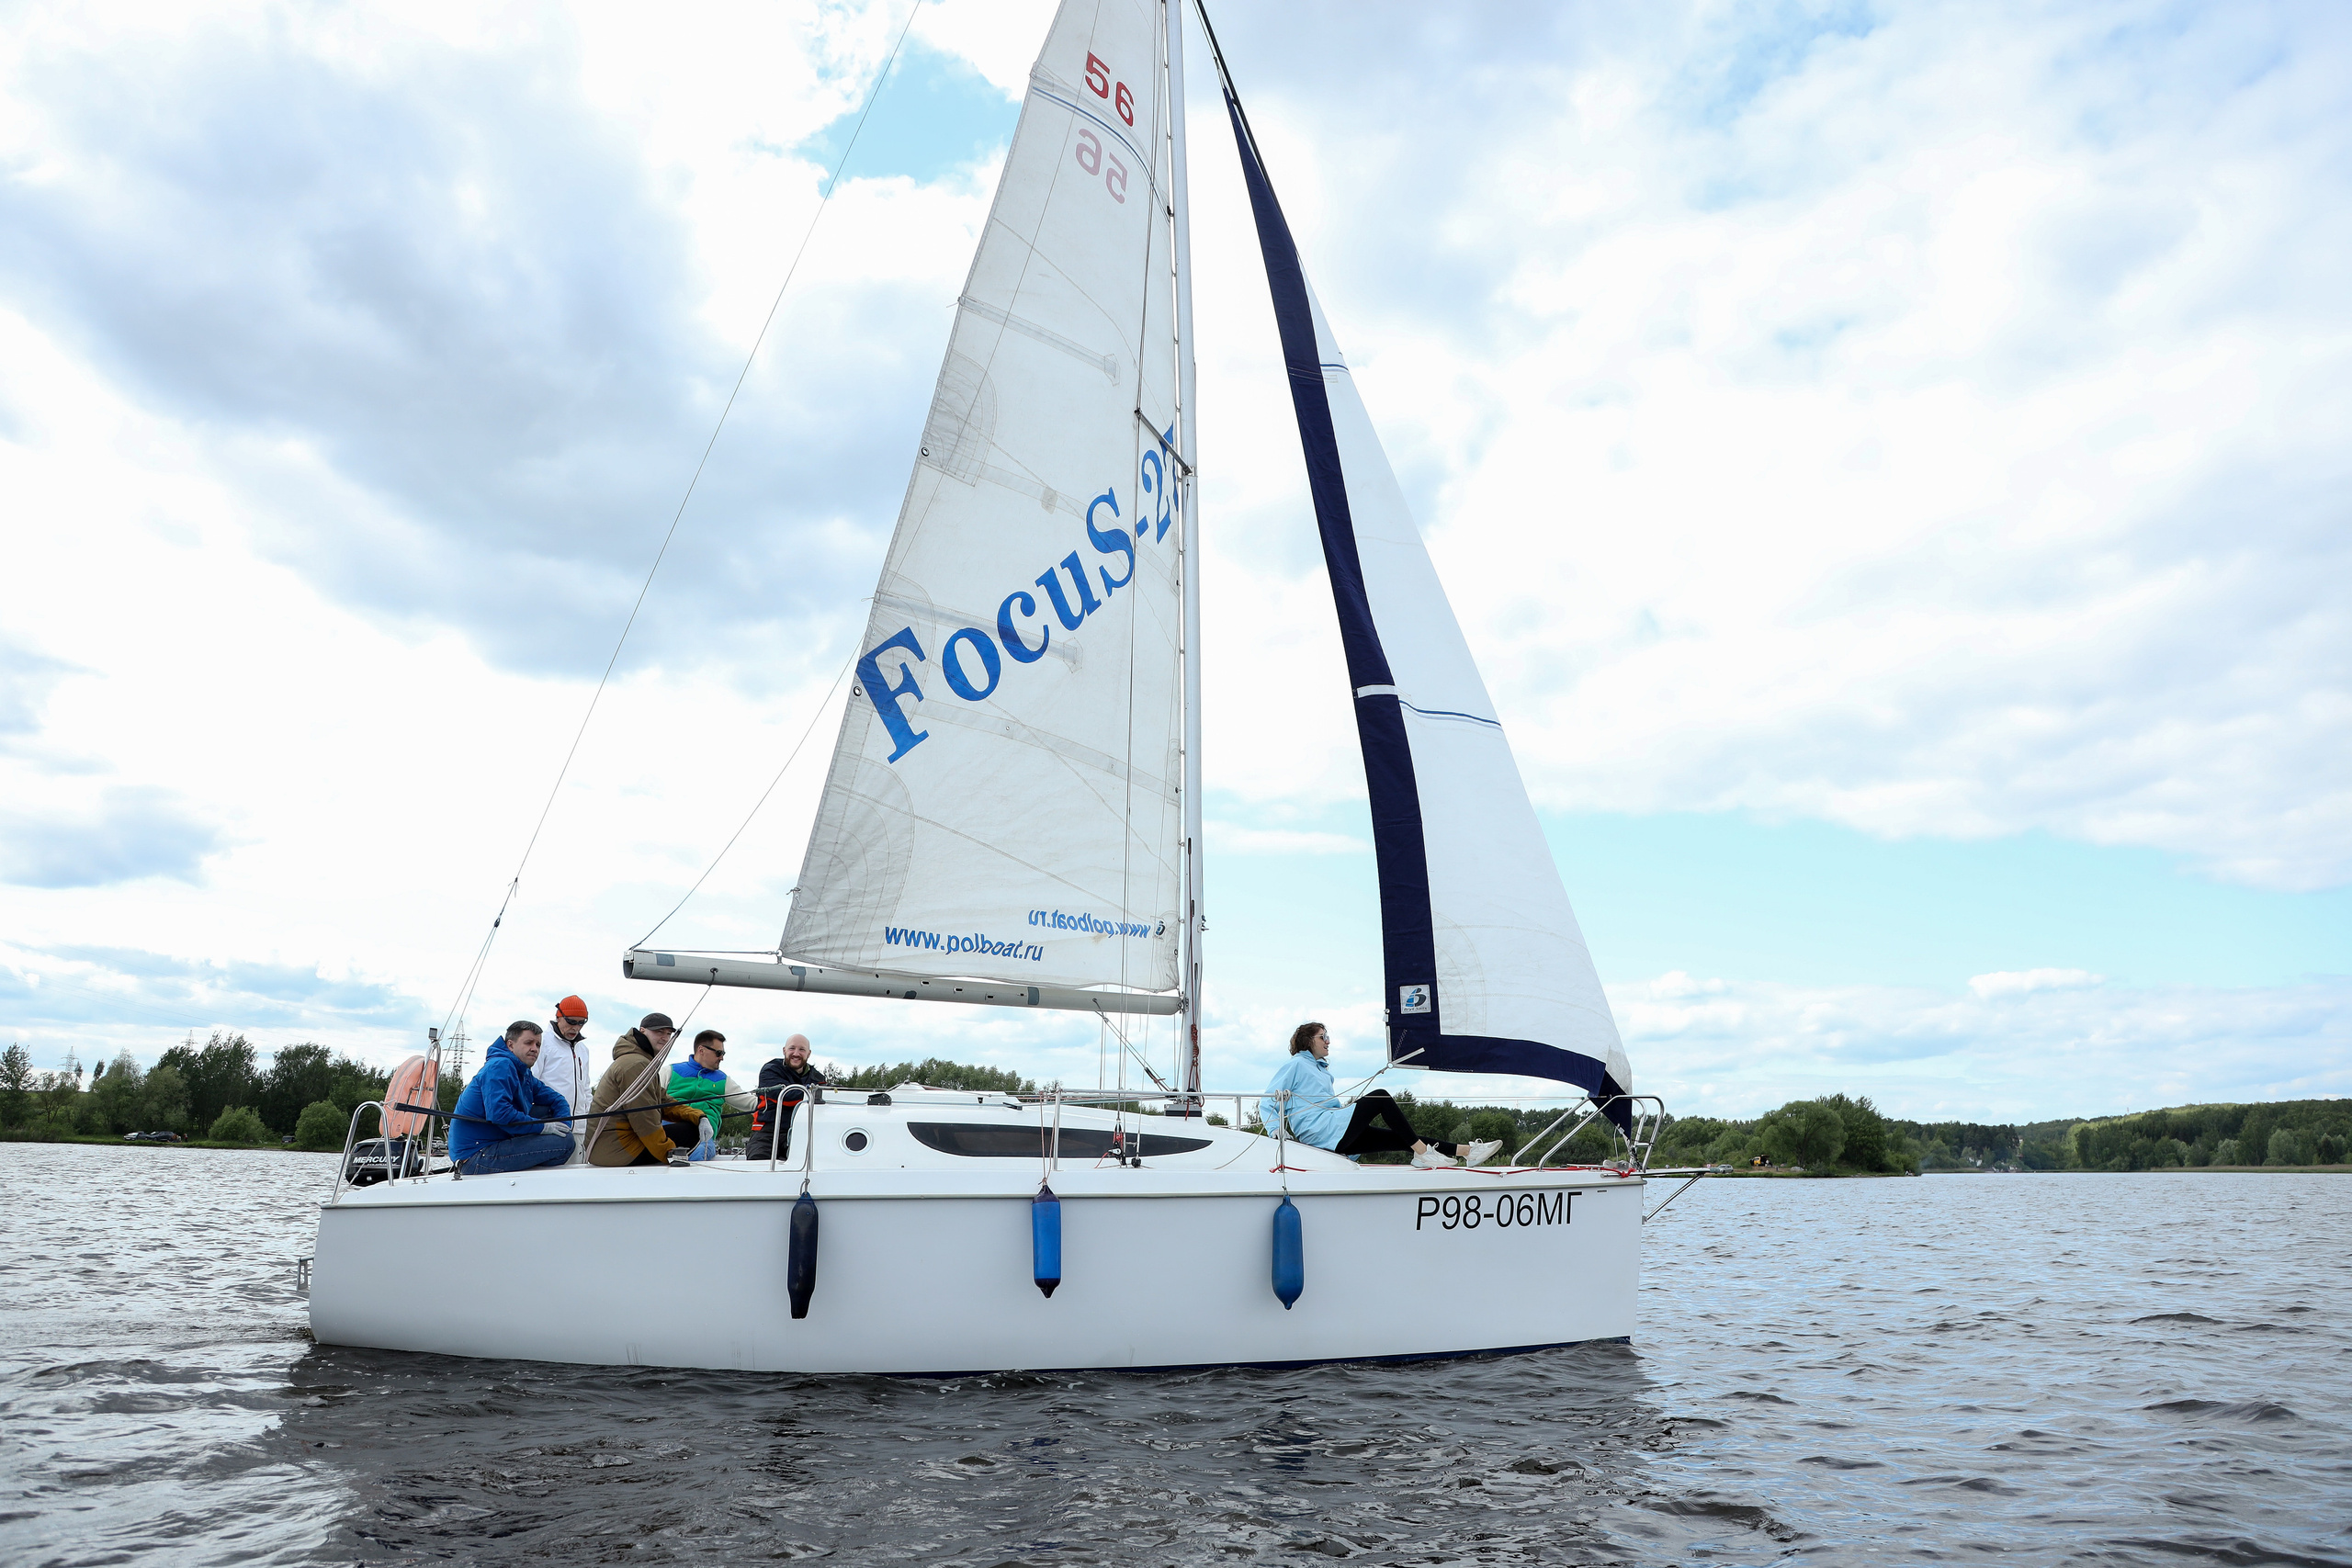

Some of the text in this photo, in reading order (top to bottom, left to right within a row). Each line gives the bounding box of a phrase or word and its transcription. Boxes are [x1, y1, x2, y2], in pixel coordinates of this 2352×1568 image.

[1085, 51, 1135, 127] 56
[885, 926, 1044, 962] www.polboat.ru
[1416, 1191, 1583, 1231] Р98-06МГ
